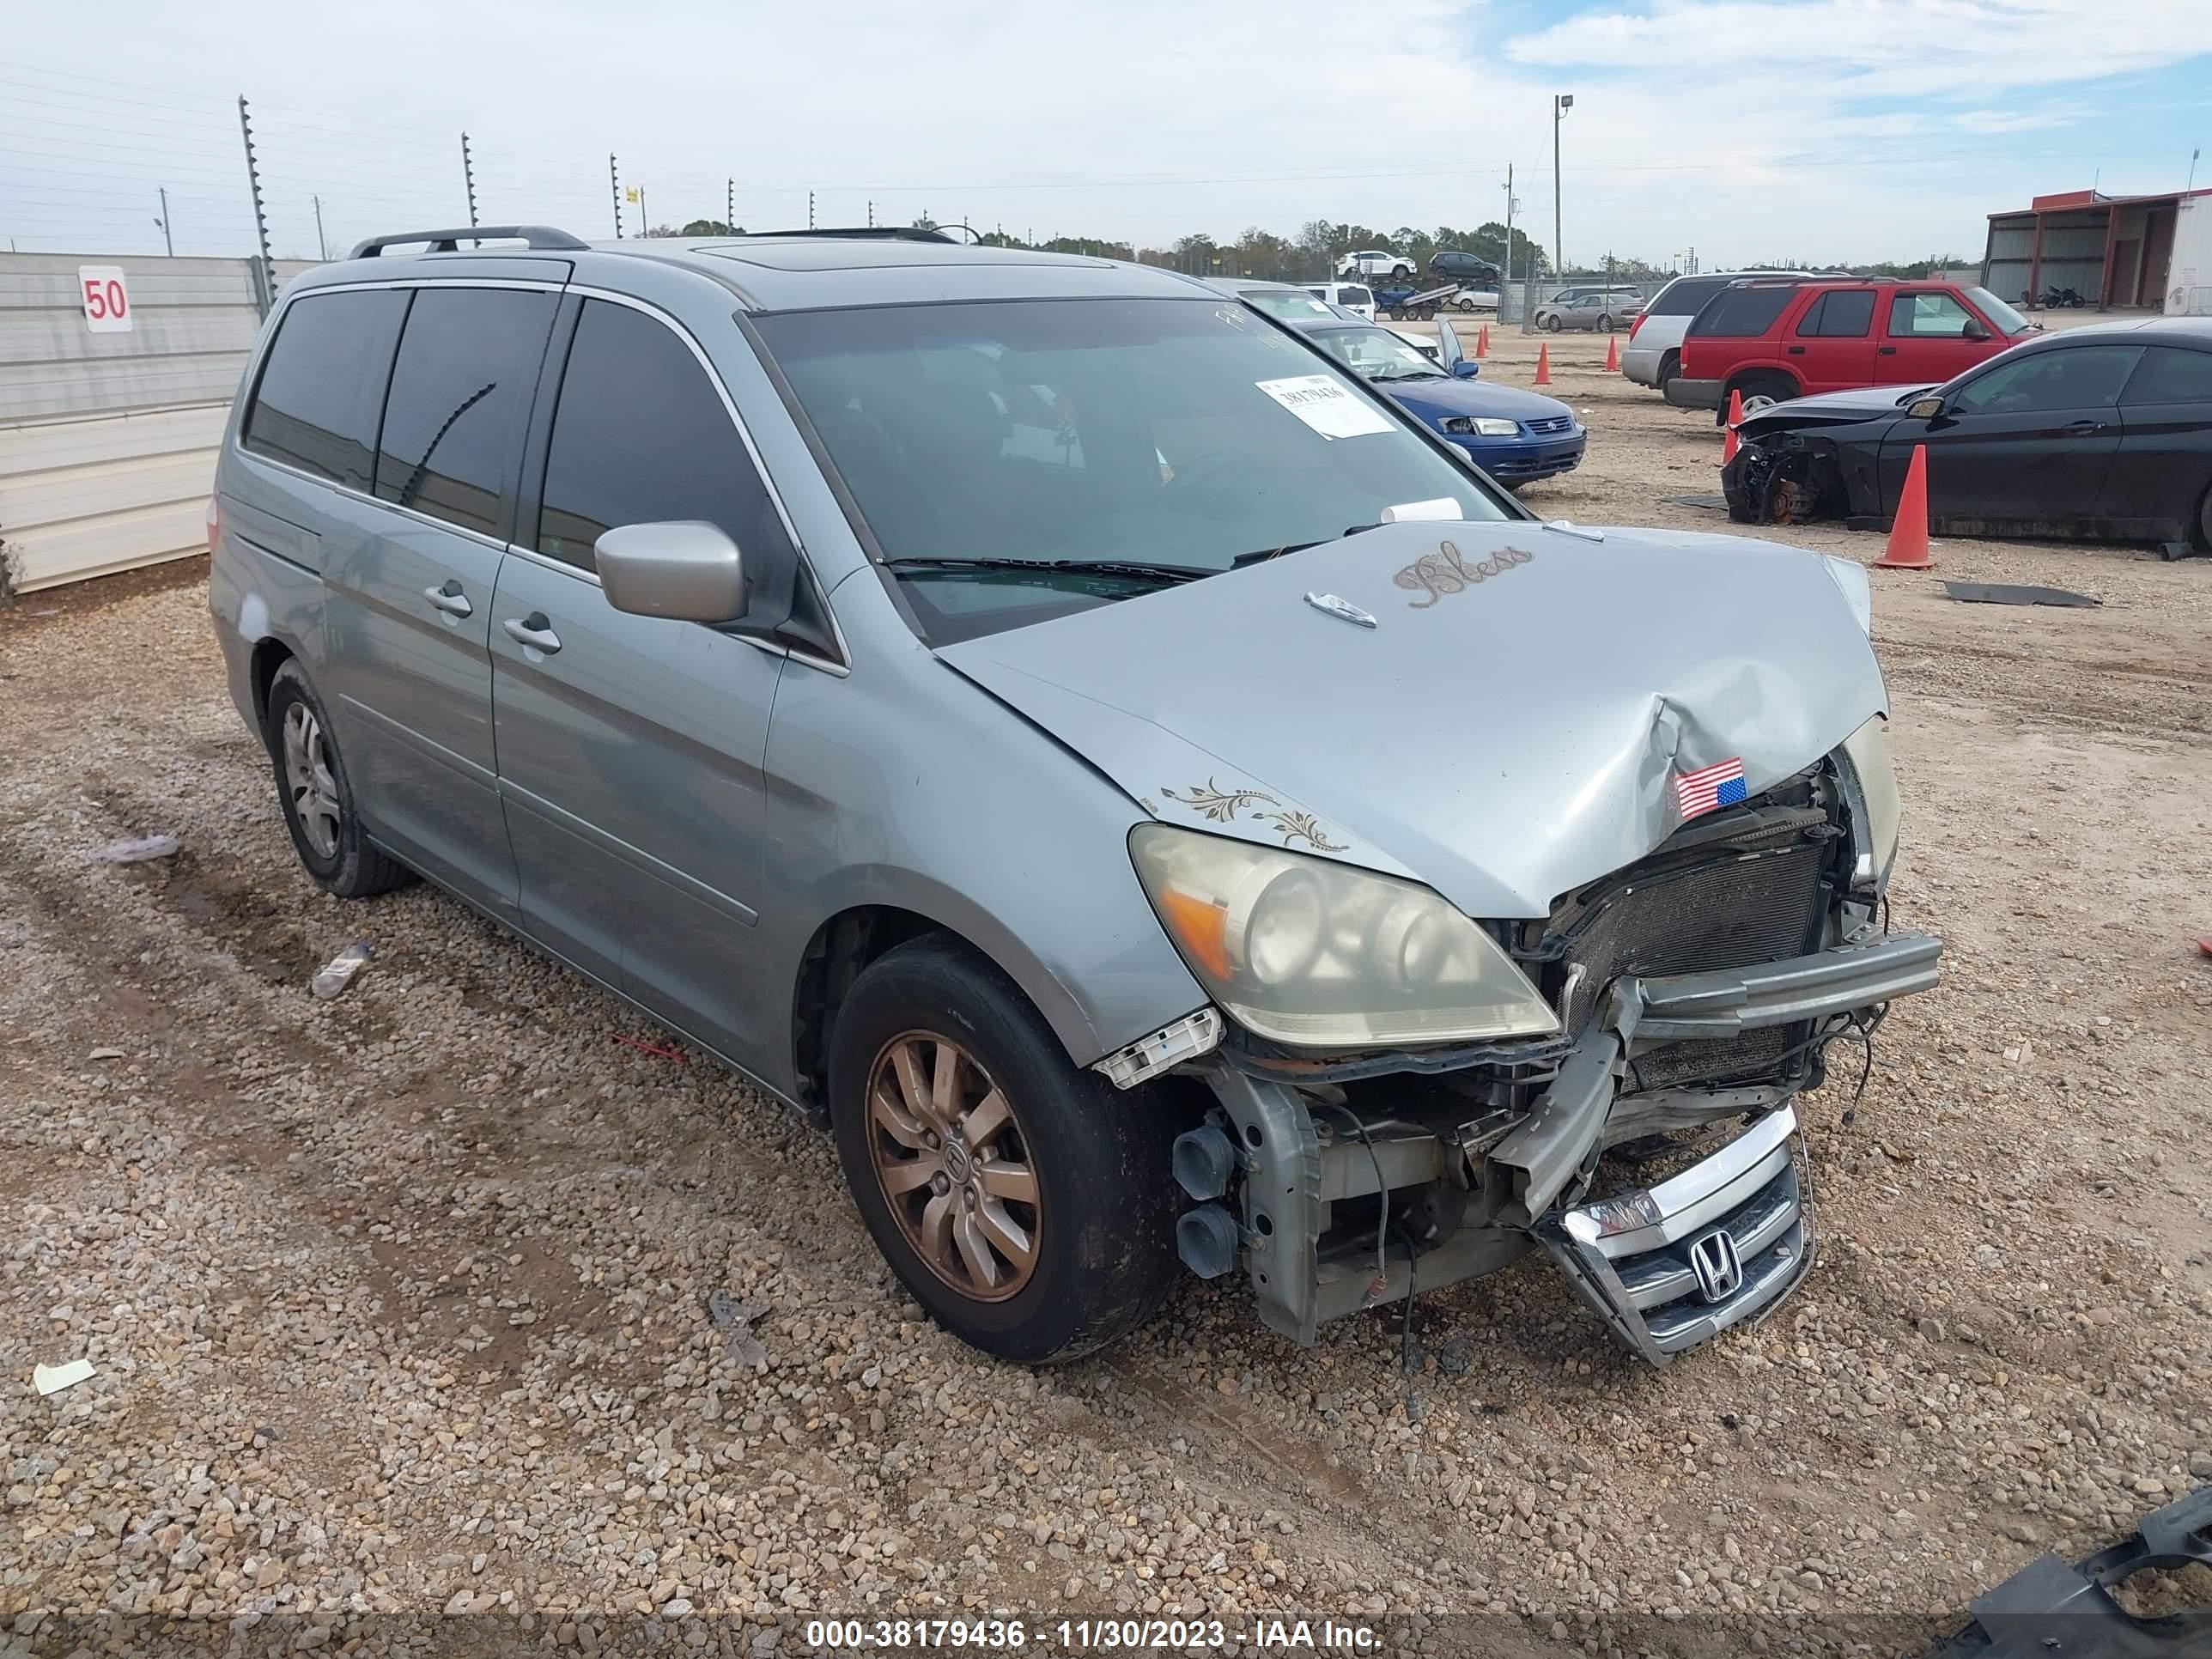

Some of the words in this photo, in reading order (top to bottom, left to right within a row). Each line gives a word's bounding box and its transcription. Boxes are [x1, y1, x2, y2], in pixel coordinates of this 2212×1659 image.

[84, 280, 125, 319] 50
[1280, 387, 1345, 405] 38179436
[1395, 540, 1534, 609] Bless
